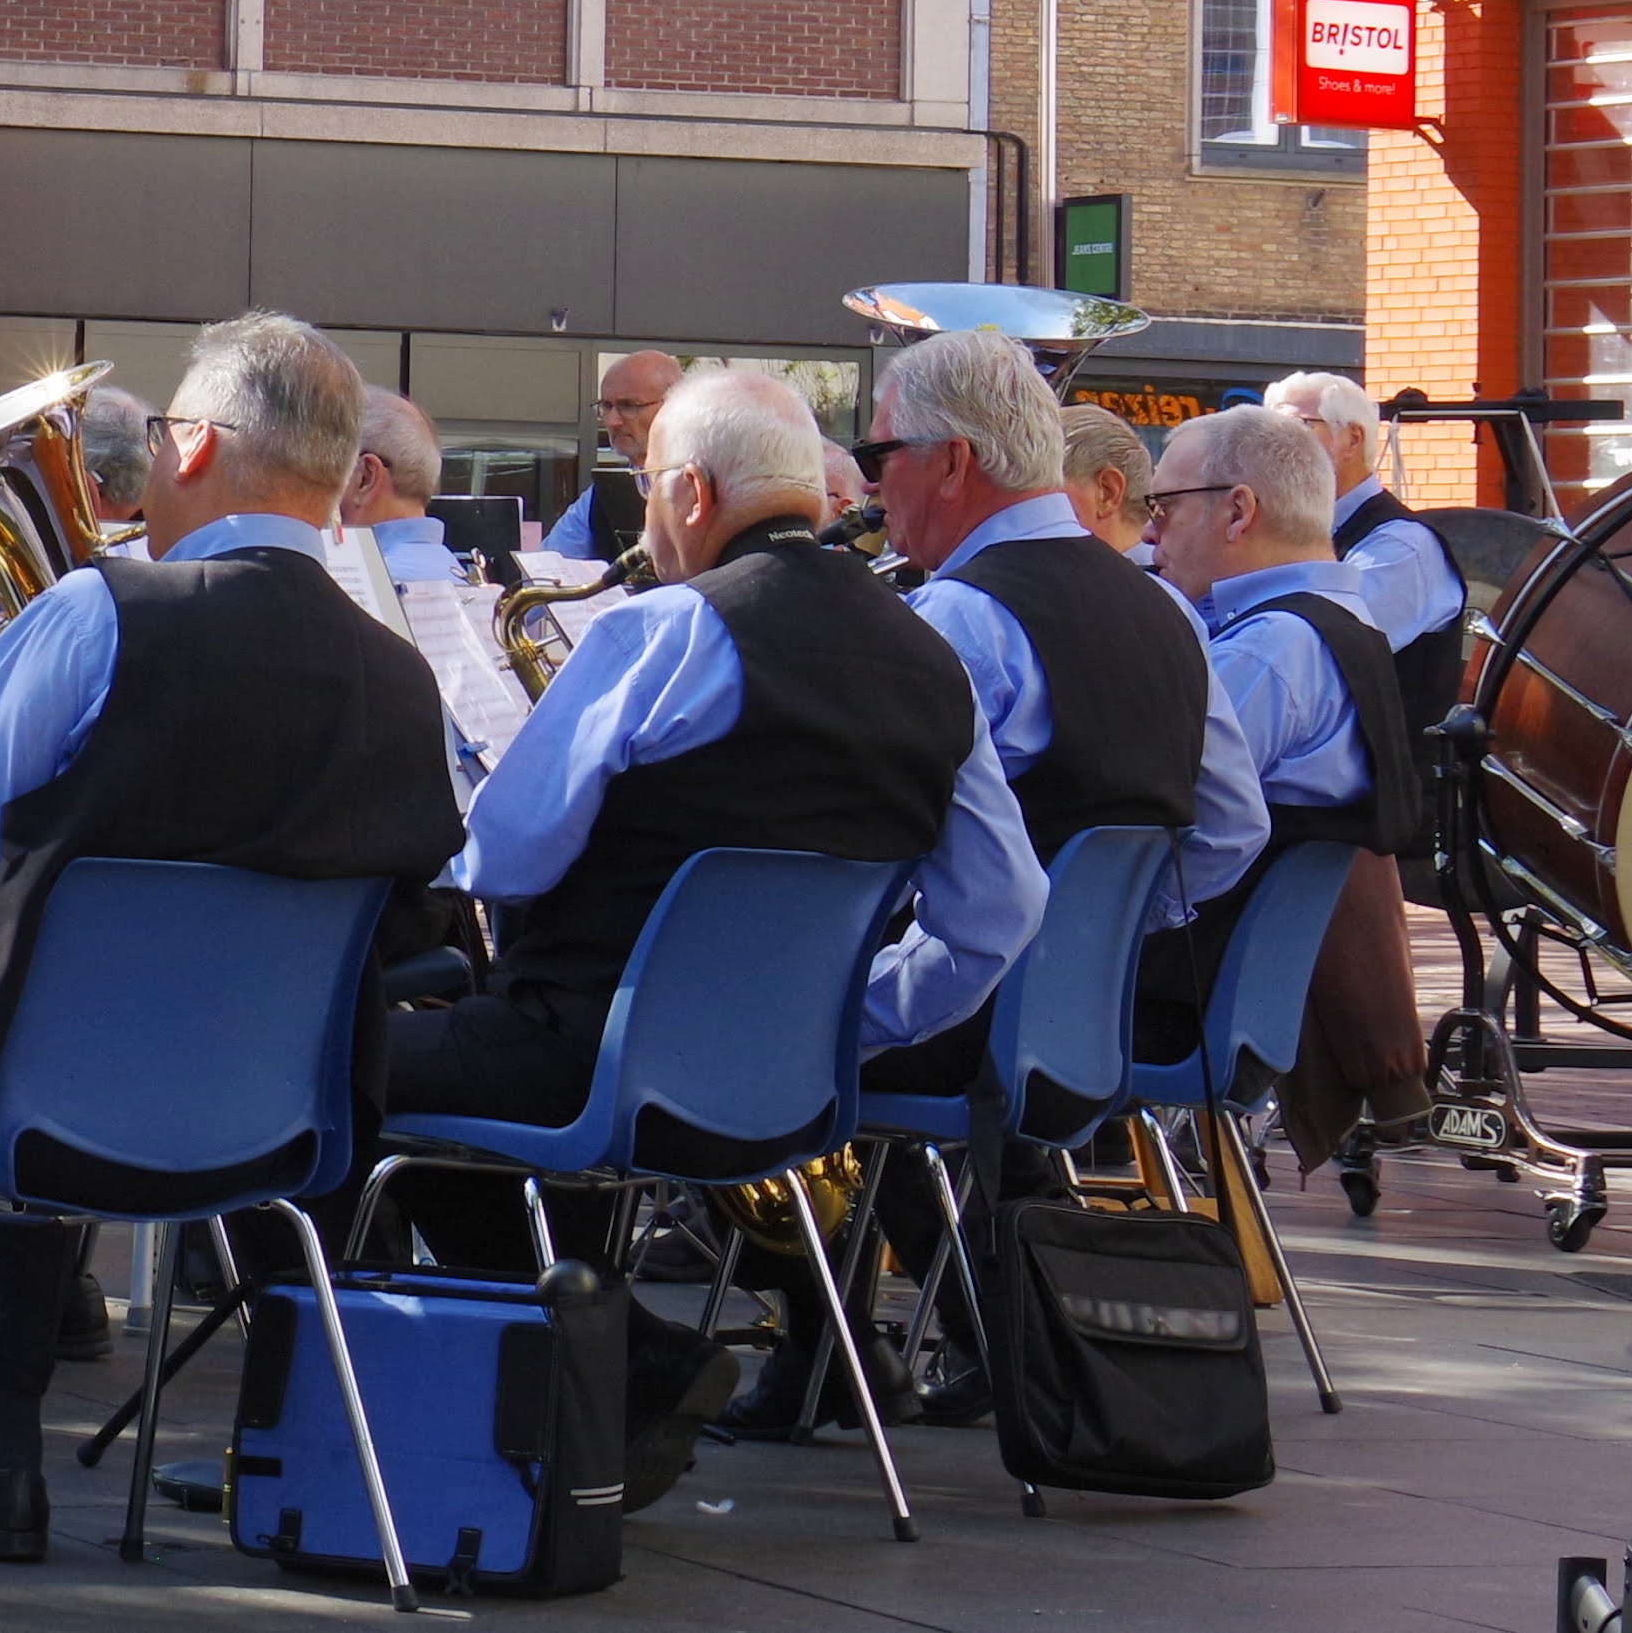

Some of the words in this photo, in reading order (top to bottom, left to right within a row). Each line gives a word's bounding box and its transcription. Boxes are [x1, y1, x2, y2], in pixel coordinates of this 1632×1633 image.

[1318, 76, 1351, 92] Shoes
[1353, 78, 1363, 93] &
[1364, 82, 1397, 96] more!
[1438, 1108, 1497, 1144] ADAMS
